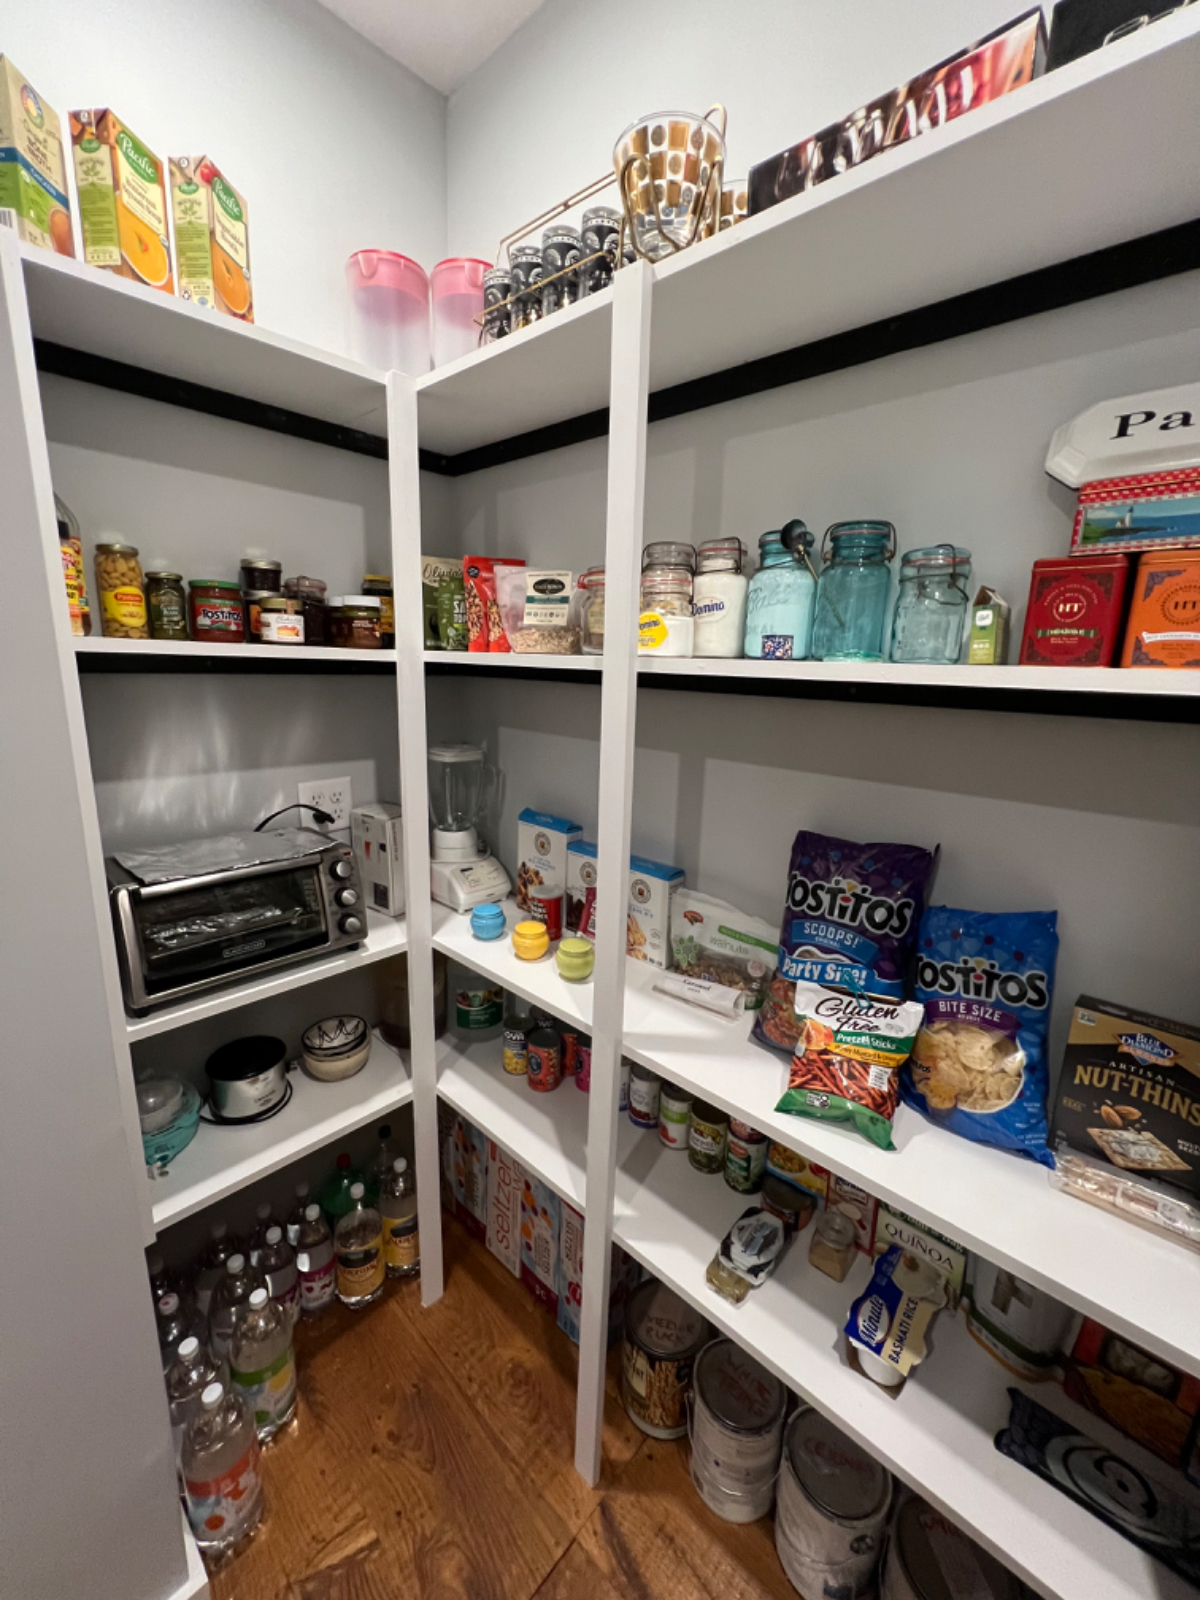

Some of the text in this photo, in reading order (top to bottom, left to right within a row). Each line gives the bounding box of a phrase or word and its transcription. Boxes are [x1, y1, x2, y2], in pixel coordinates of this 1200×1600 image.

[120, 132, 155, 177] Pacific
[214, 178, 241, 215] Pacific
[1110, 410, 1196, 440] Pa
[691, 599, 725, 616] Domino
[638, 618, 661, 630] omino
[709, 935, 750, 955] walnuts
[804, 923, 860, 948] SCOOPS!
[783, 958, 867, 986] Party Sie!
[938, 1000, 1002, 1022] BITE SIZE
[836, 1016, 882, 1033] Free
[836, 1033, 896, 1050] Pretzel Sticks
[1120, 1035, 1175, 1058] DIAMOND
[1136, 1033, 1160, 1047] BLUE
[1109, 1061, 1175, 1087] ARTISAN
[1073, 1065, 1200, 1127] NUT-THINS
[492, 1160, 512, 1250] seltzer
[858, 1294, 887, 1348] Minute
[889, 1297, 920, 1364] BASMATI RICE
